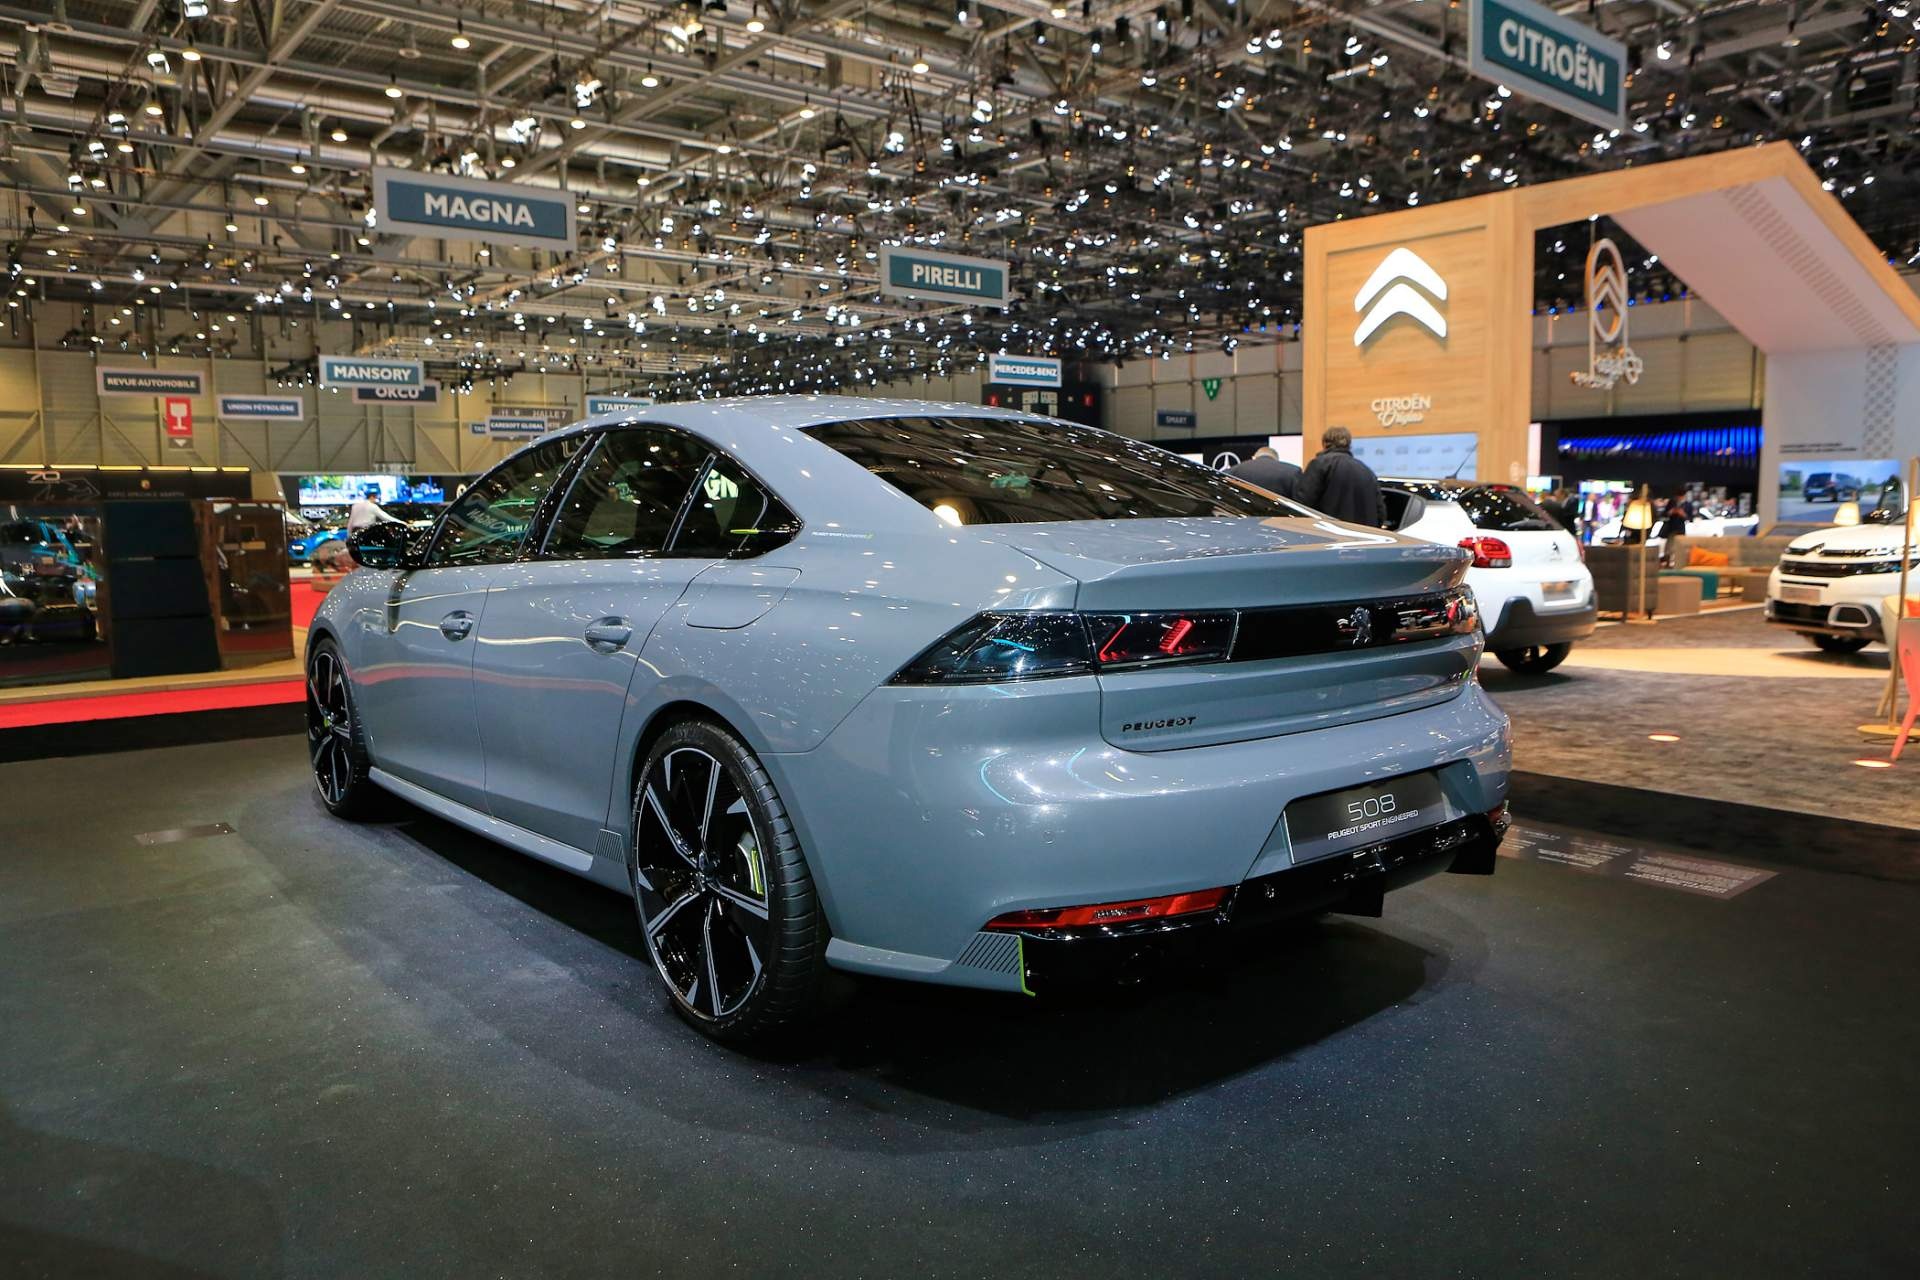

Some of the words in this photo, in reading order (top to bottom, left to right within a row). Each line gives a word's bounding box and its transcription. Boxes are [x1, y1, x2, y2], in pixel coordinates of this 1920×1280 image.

[1498, 18, 1606, 97] CITROËN
[423, 191, 536, 229] MAGNA
[911, 263, 982, 291] PIRELLI
[333, 364, 413, 382] MANSORY
[994, 364, 1058, 377] MERCEDES-BENZ
[107, 377, 136, 388] REVUE
[137, 378, 197, 389] AUTOMOBILE
[1370, 393, 1432, 413] CITROËN
[1122, 716, 1197, 733] PEUGEOT
[1347, 793, 1396, 822] 508
[1327, 825, 1359, 841] PEUGEOT
[1360, 819, 1381, 833] SPORT
[1381, 809, 1419, 826] ENGINEERED
